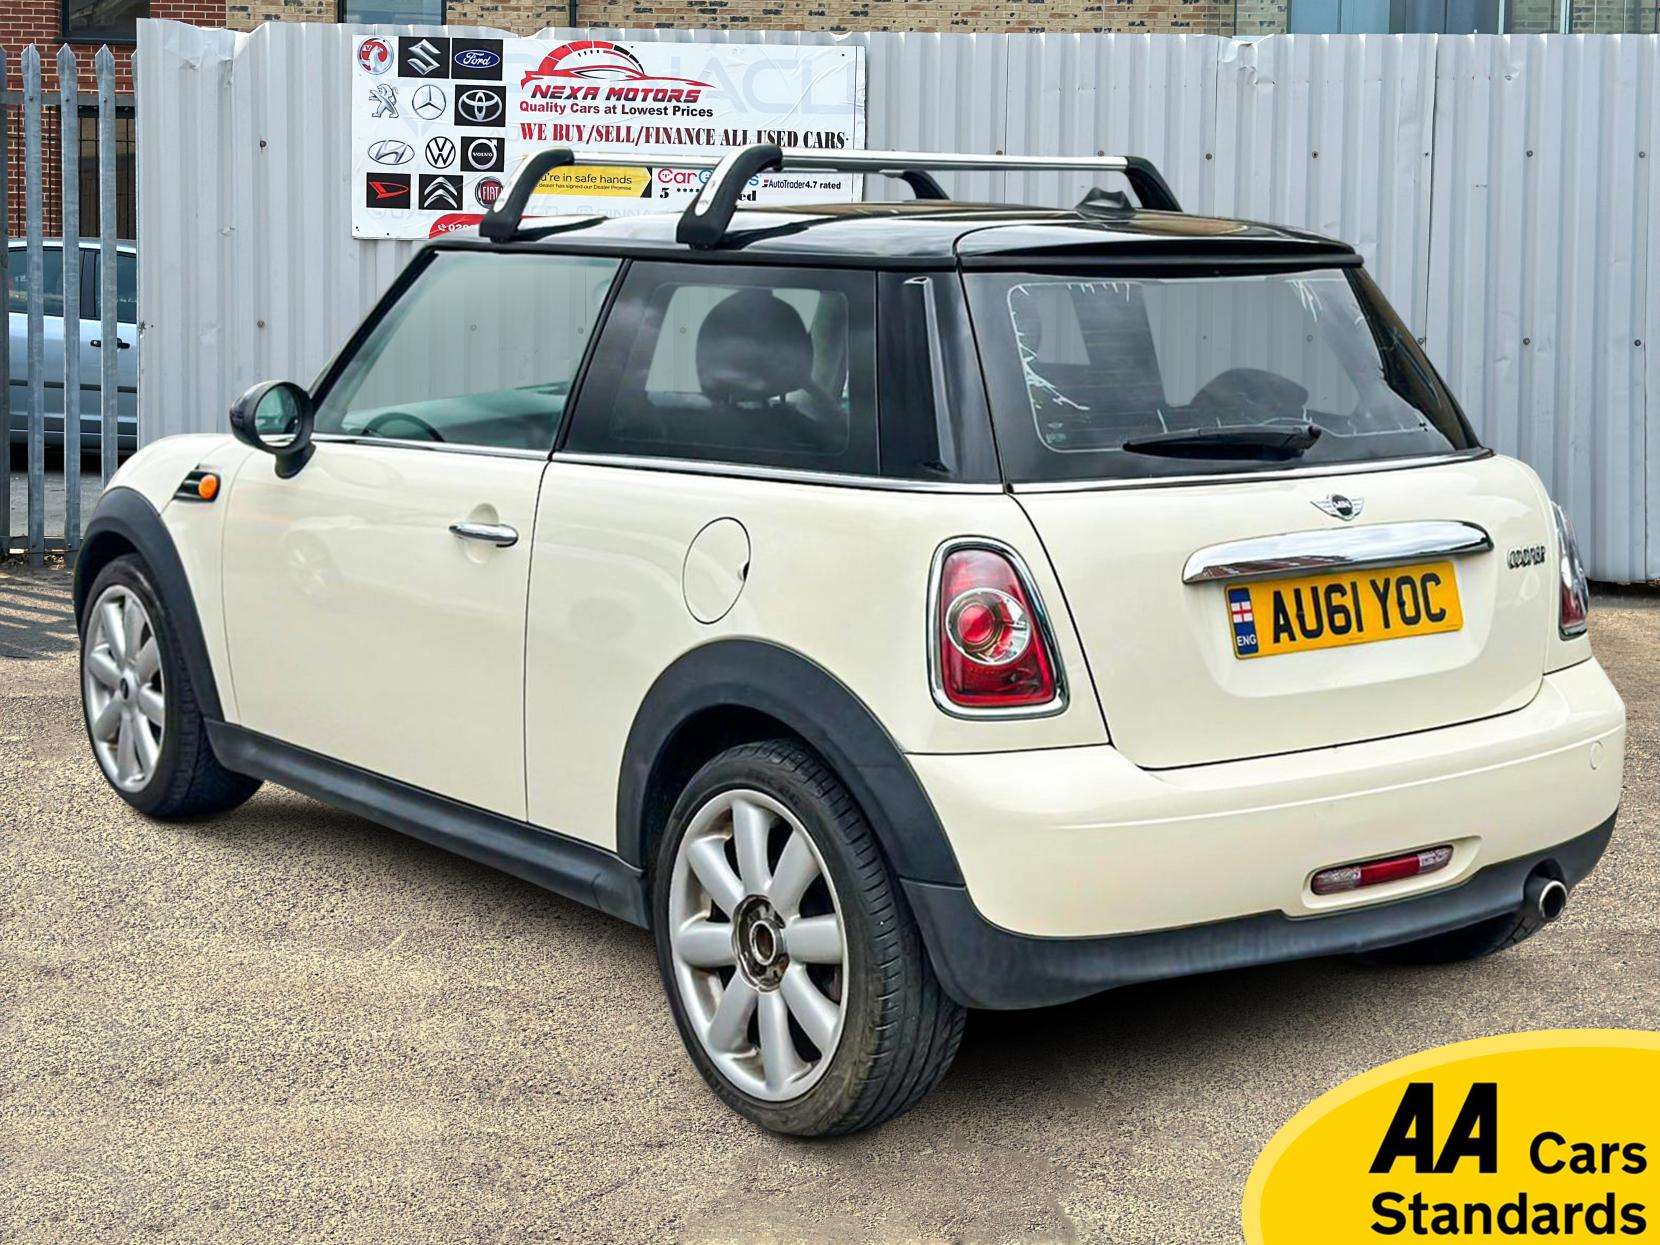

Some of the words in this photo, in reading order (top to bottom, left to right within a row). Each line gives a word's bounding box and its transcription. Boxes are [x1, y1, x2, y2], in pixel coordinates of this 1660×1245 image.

[463, 51, 491, 66] Ford
[530, 84, 600, 101] NEXA
[605, 86, 702, 104] MOTORS
[519, 101, 566, 115] Quality
[570, 102, 600, 114] Cars
[604, 104, 617, 115] at
[621, 104, 669, 116] Lowest
[672, 105, 714, 117] Prices
[519, 122, 547, 141] WE
[719, 128, 753, 146] ALL
[756, 129, 799, 148] USED
[562, 173, 572, 182] in
[575, 174, 597, 183] safe
[599, 174, 633, 184] hands
[819, 181, 842, 190] rated
[482, 186, 499, 201] FIAT
[659, 187, 670, 199] 5
[1272, 581, 1364, 645] AU61
[1369, 572, 1447, 630] YOC
[1236, 634, 1257, 647] ENG
